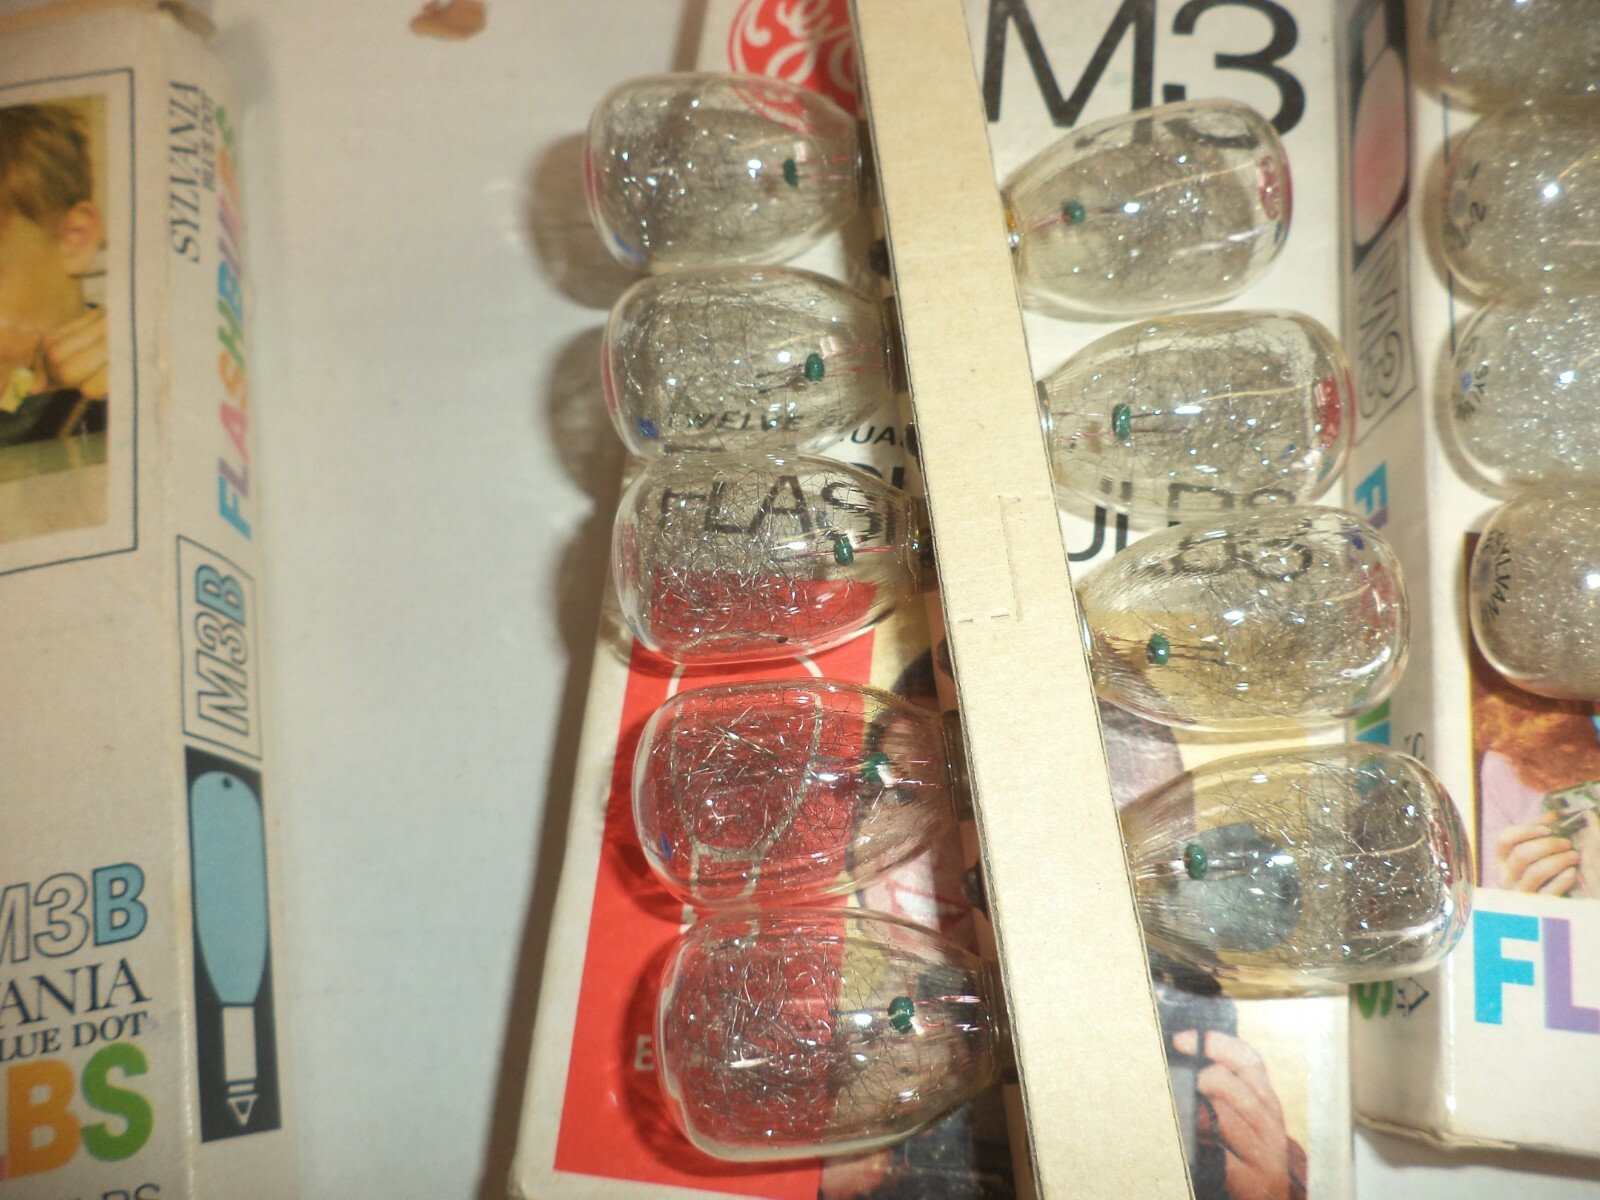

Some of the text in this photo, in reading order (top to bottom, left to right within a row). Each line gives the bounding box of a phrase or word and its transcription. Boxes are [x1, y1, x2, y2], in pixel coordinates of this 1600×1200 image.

[982, 0, 1306, 138] M3
[194, 563, 249, 737] M3B
[72, 1011, 148, 1048] DOT
[1474, 910, 1600, 1034] FL
